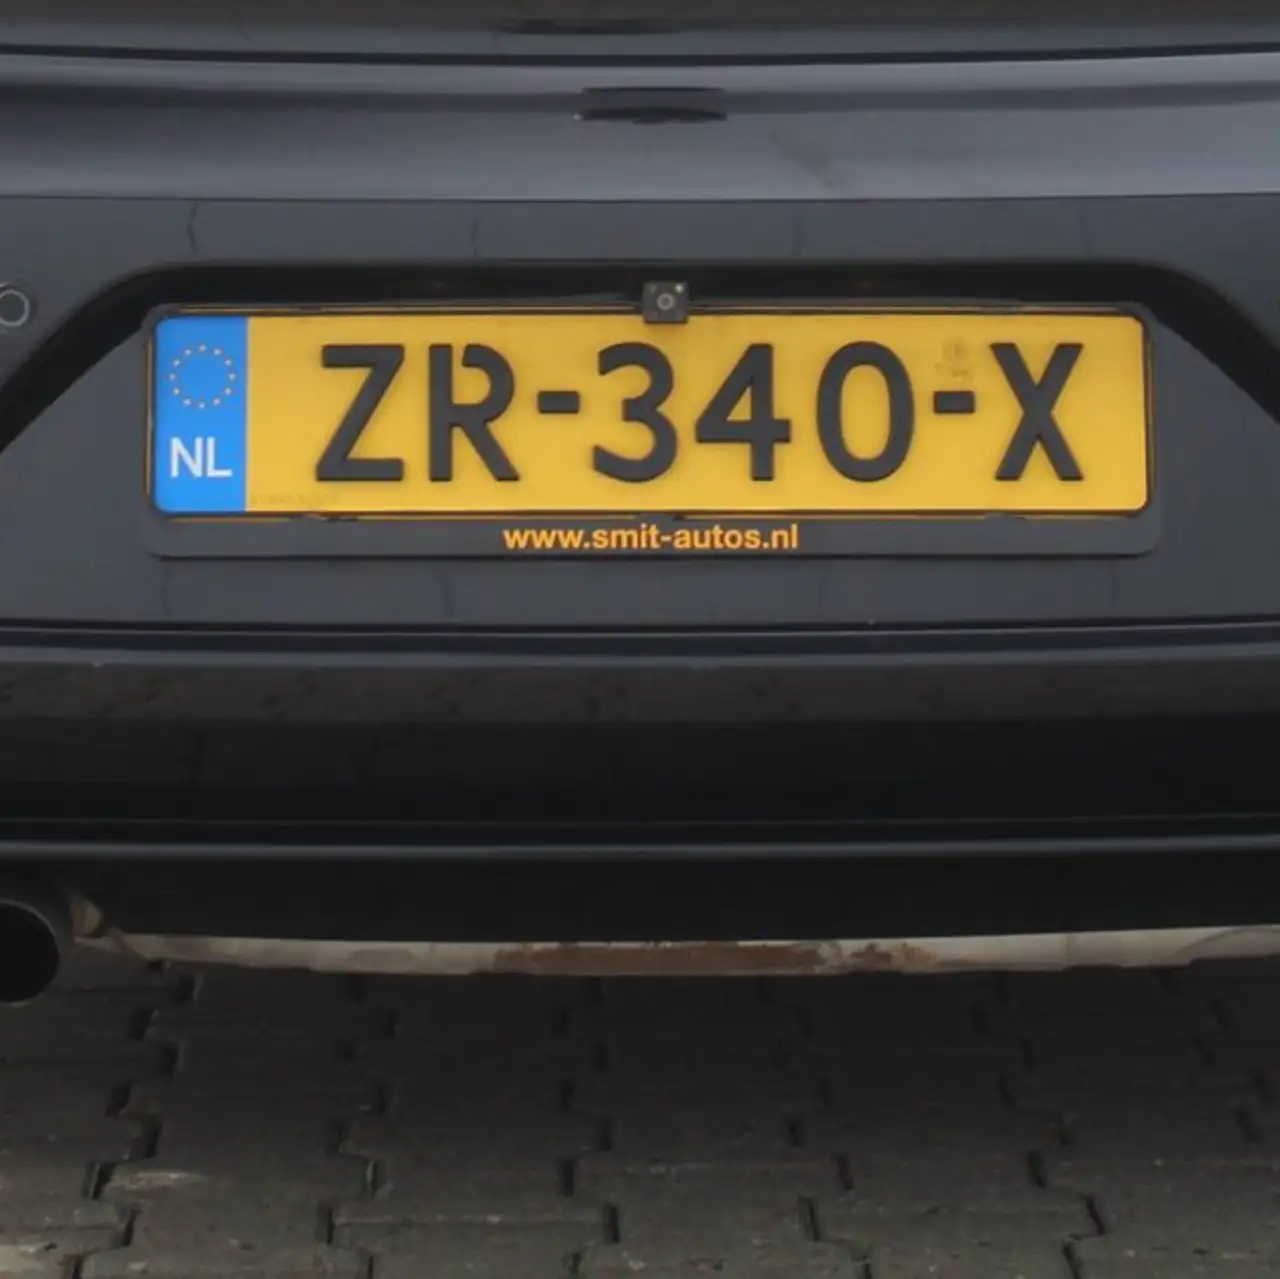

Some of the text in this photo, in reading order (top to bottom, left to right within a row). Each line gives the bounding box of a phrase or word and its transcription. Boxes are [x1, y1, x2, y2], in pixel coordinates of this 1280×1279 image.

[170, 341, 1084, 484] NL ZR-340-X
[503, 523, 799, 550] www.smit-autos.nl
